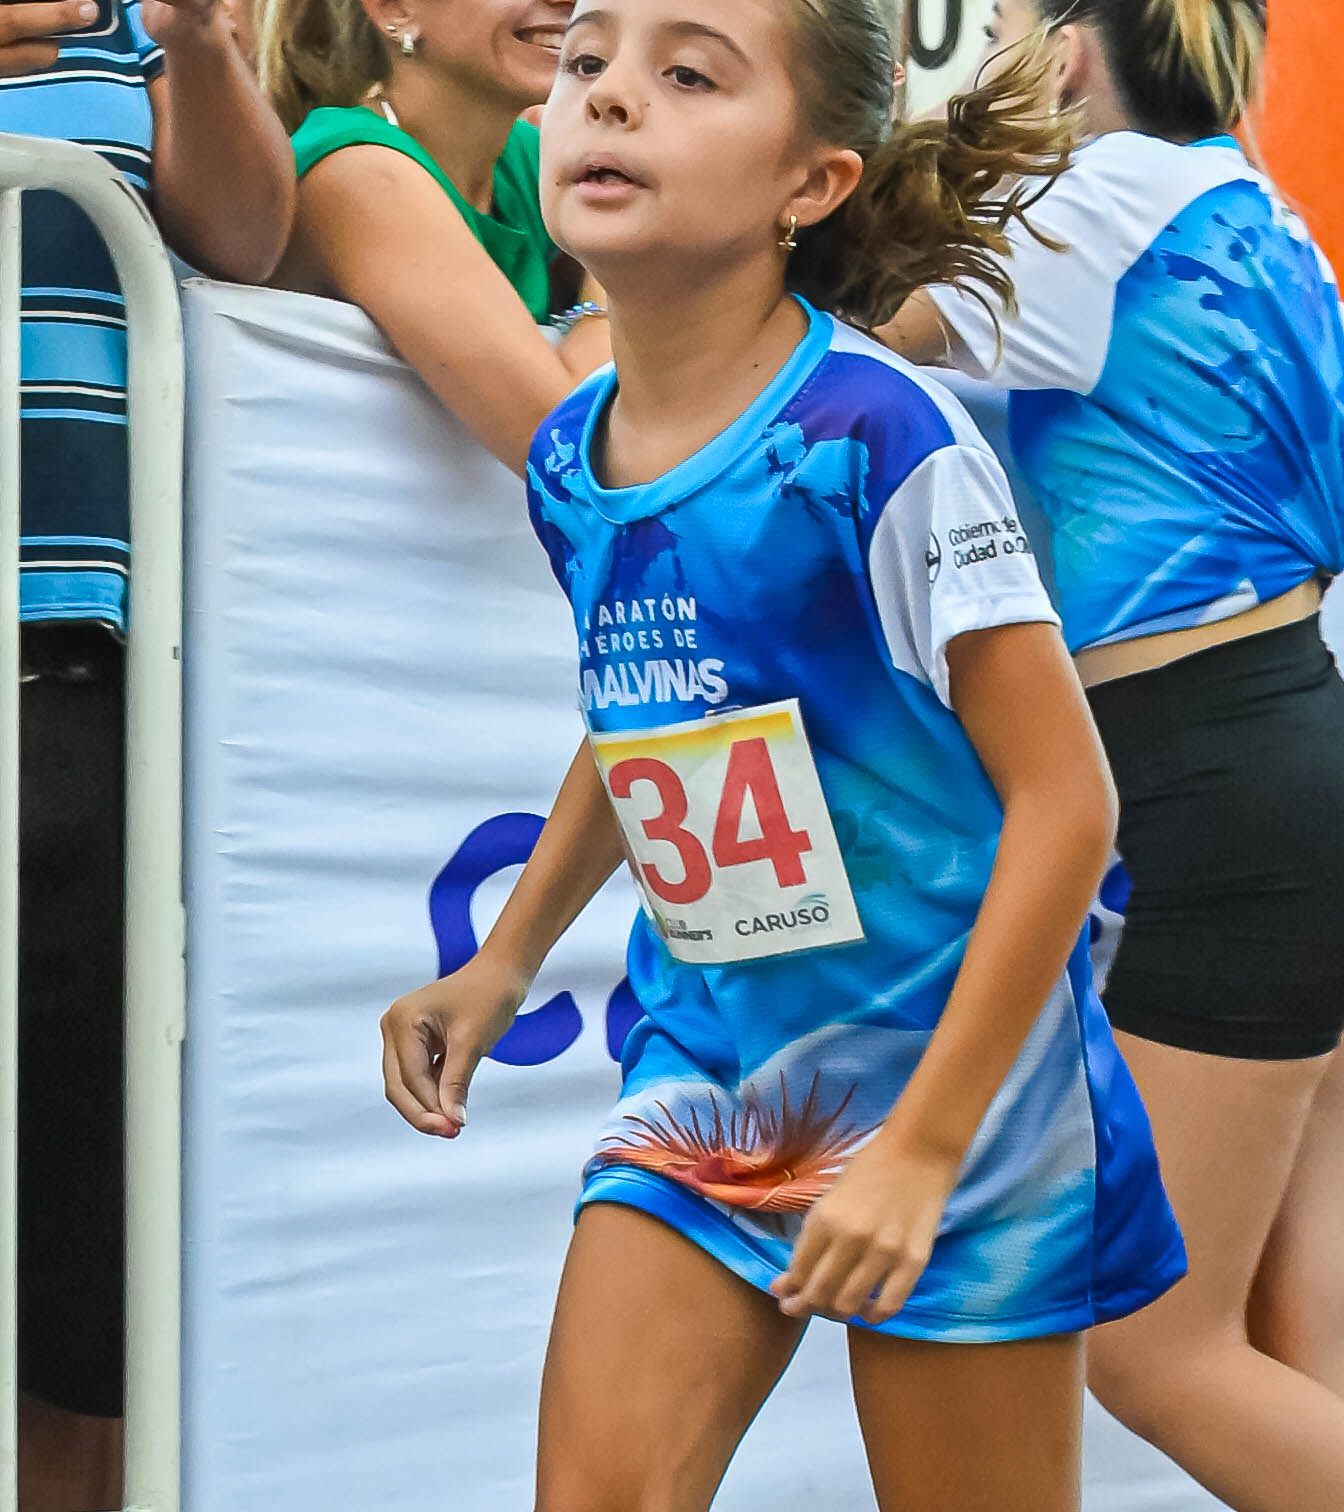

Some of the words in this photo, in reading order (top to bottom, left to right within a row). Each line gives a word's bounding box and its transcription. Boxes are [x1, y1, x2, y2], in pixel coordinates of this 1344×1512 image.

[673, 628, 698, 649] DE
[608, 736, 813, 905] 34
[735, 904, 830, 937] CARUSO
